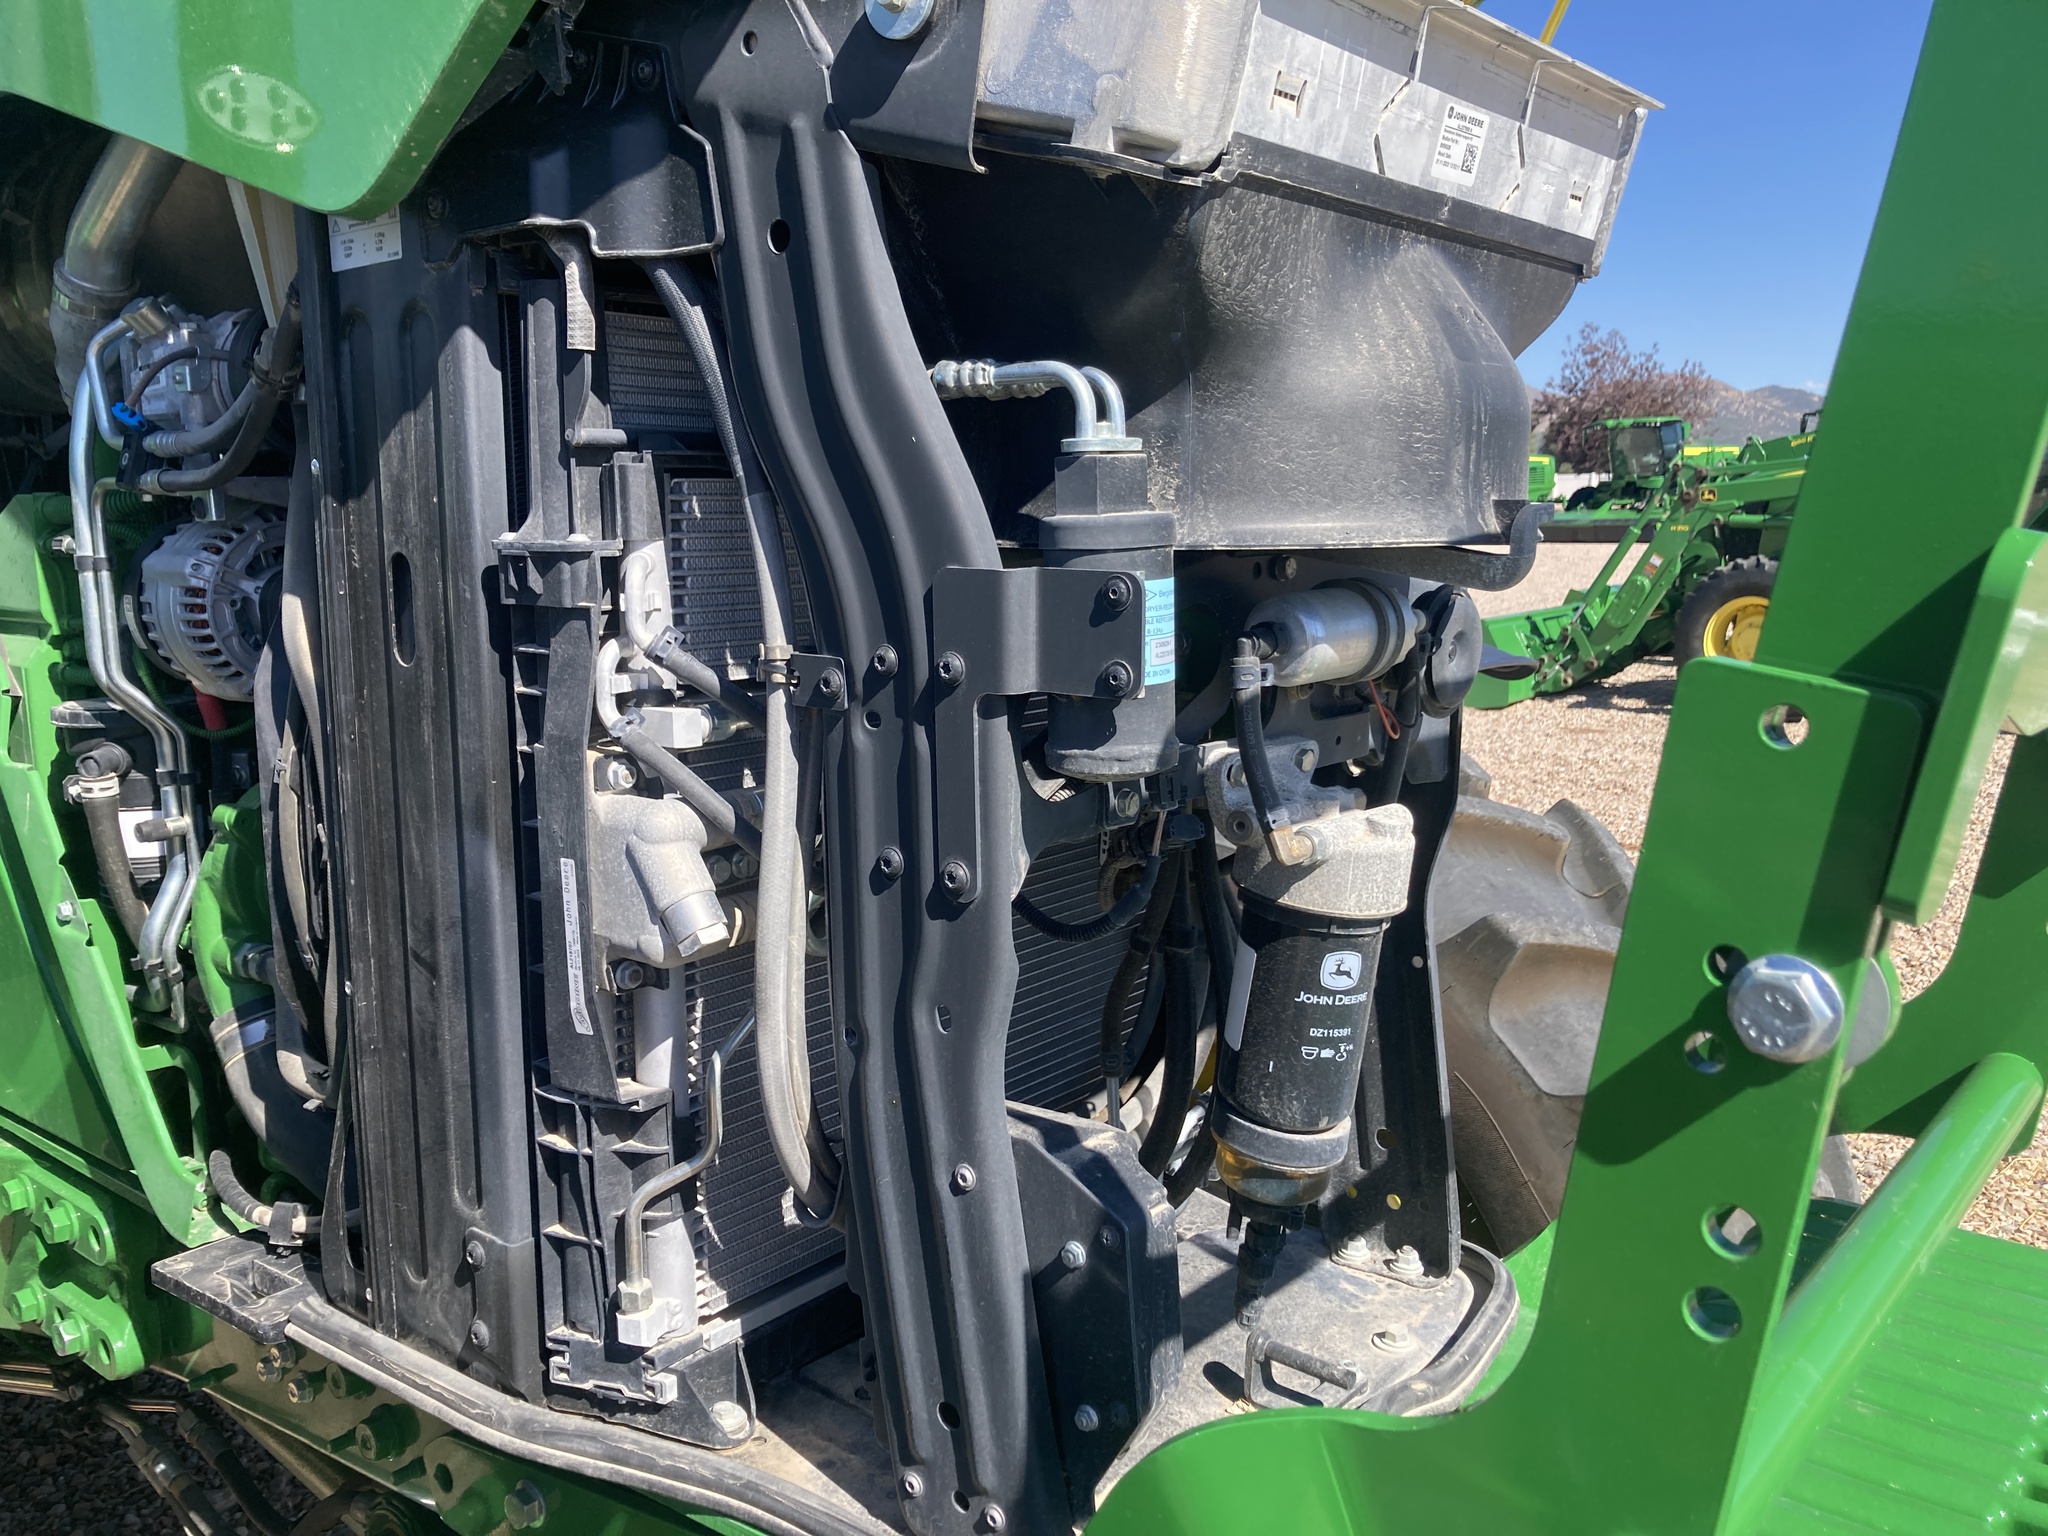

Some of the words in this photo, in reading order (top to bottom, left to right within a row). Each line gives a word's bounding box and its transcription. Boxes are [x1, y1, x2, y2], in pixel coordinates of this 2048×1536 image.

[1454, 112, 1468, 122] JOHN
[1468, 116, 1484, 128] DEERE
[1294, 991, 1333, 1006] JOHN
[1334, 992, 1368, 1006] DEERE
[1310, 1028, 1351, 1037] DZ115391
